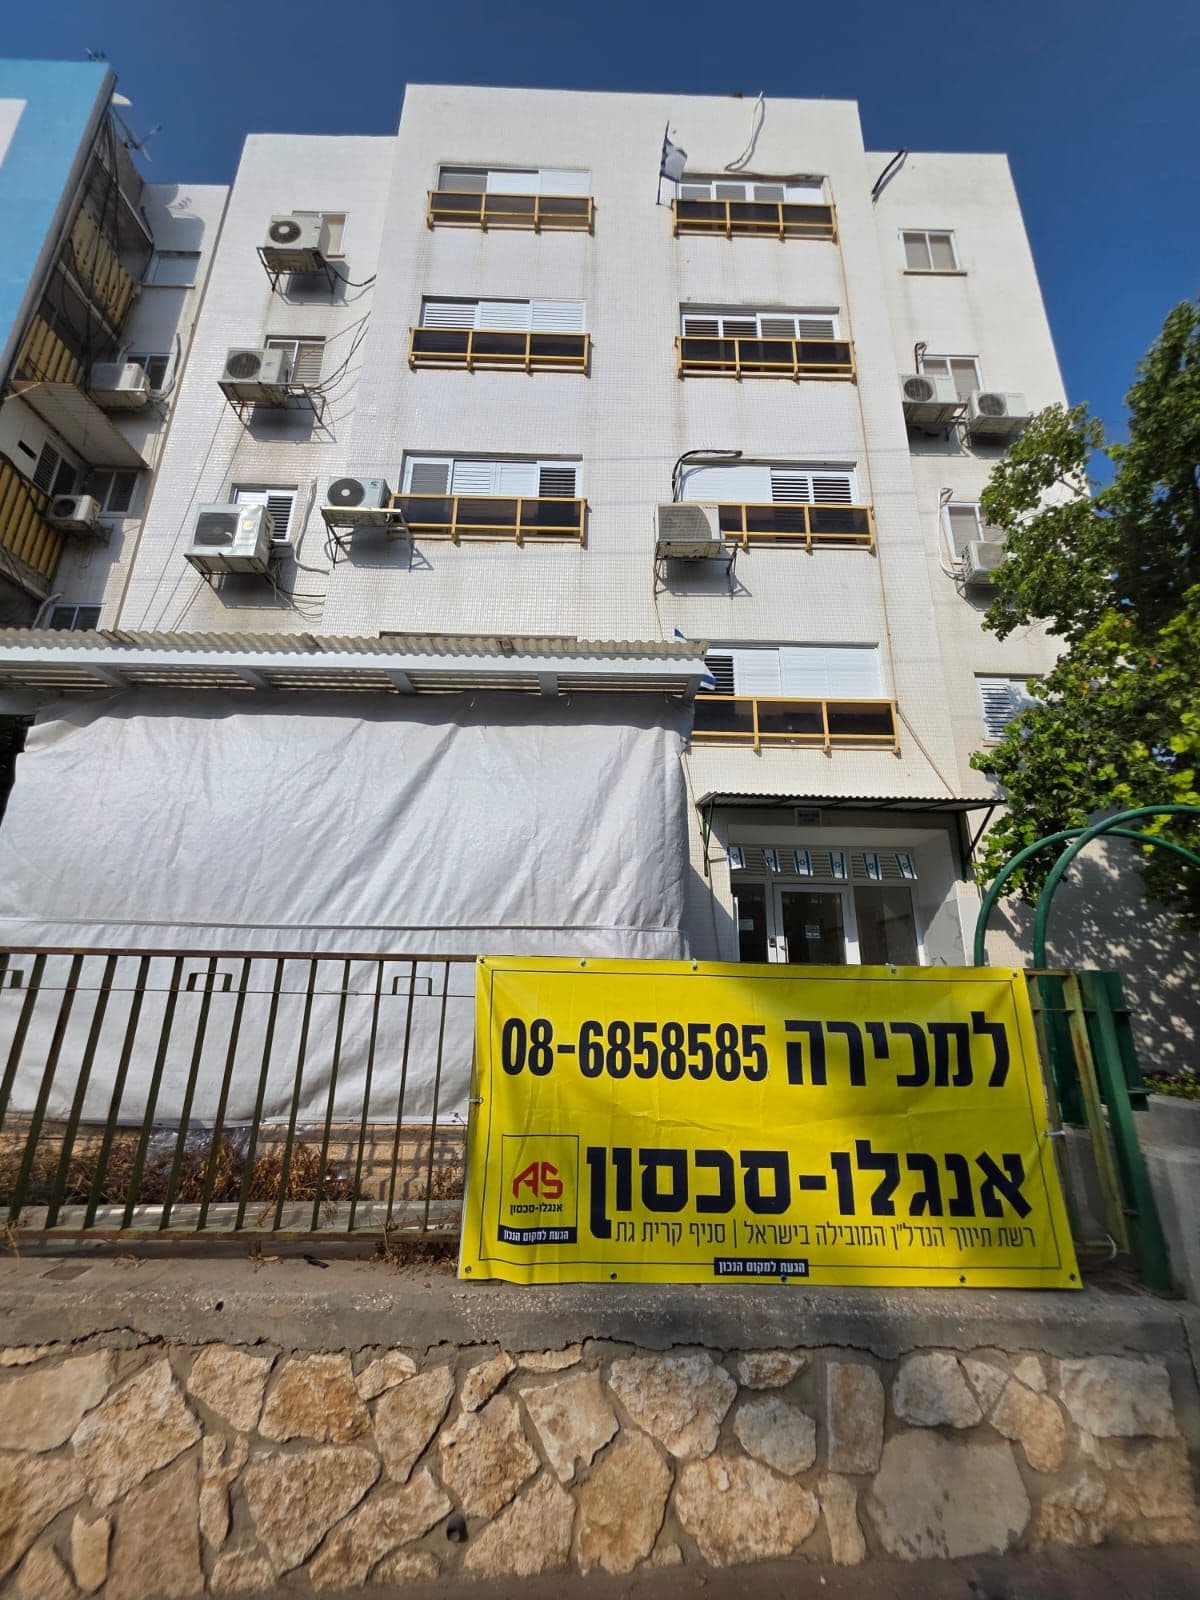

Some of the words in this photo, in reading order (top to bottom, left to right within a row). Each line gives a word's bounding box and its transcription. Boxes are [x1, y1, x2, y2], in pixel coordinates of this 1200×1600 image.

[502, 1018, 768, 1082] 08-6858585
[785, 1012, 1010, 1088] למכירה
[512, 1161, 564, 1200] AS
[587, 1140, 1034, 1240] אנגלו-סכסון
[510, 1203, 563, 1215] אנגלו-סכסון
[523, 1228, 546, 1243] למקום
[615, 1221, 635, 1243] גת
[641, 1221, 683, 1247] קרית
[689, 1222, 726, 1247] סניף
[743, 1220, 810, 1245] בישראל
[816, 1221, 886, 1246] המובילה
[950, 1226, 992, 1251] תיווך
[997, 1226, 1036, 1248] רשת
[719, 1261, 743, 1274] הנכון
[746, 1260, 777, 1274] למקום
[780, 1262, 805, 1273] הגעת
